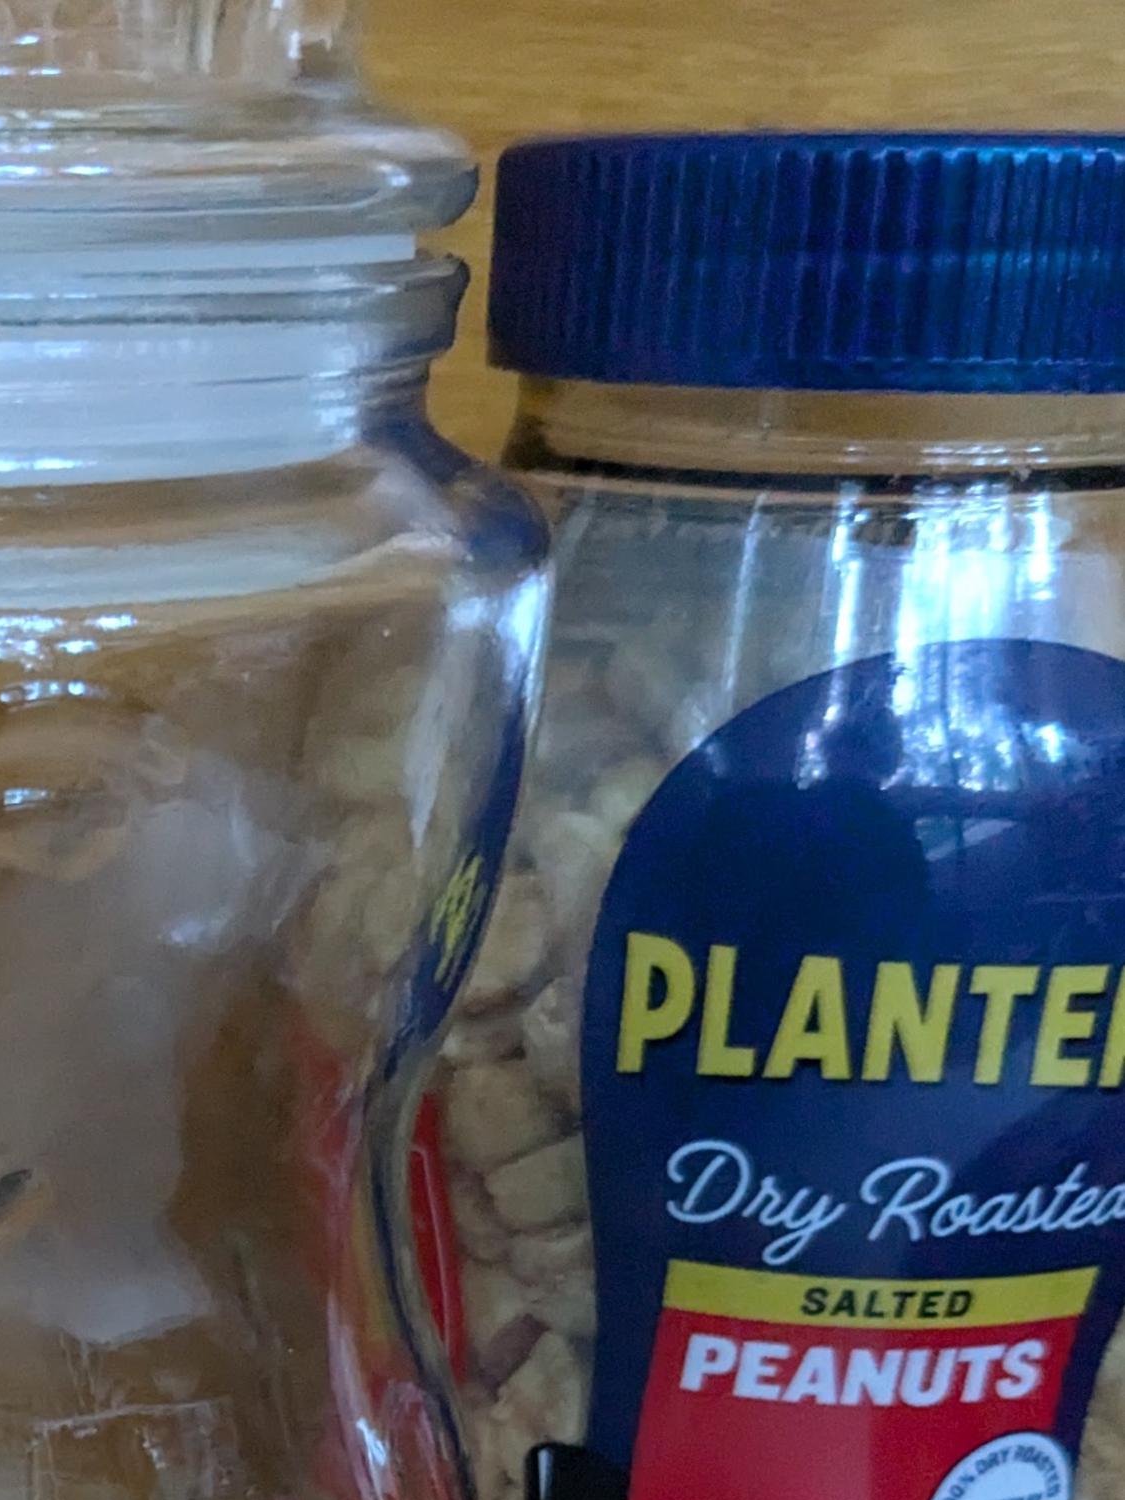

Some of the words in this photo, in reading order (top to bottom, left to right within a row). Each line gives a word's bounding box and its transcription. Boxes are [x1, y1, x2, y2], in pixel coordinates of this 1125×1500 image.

[666, 1139, 847, 1266] Dry
[800, 1287, 974, 1319] SALTED
[679, 1333, 1047, 1408] PEANUTS
